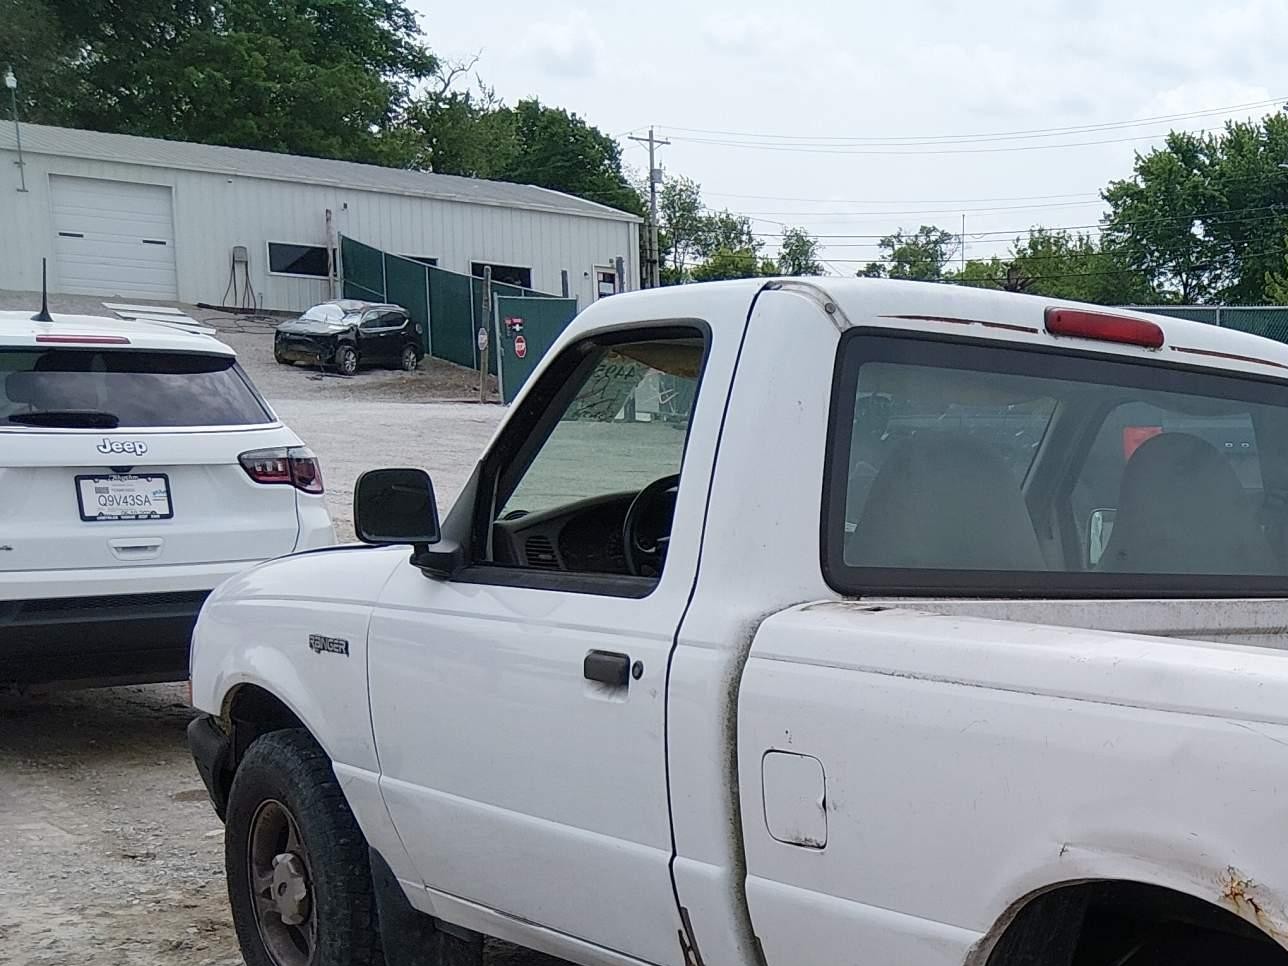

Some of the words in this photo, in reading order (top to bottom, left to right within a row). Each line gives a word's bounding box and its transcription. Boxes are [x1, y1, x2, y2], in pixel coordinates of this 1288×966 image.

[97, 438, 147, 456] Jeep
[98, 495, 152, 506] Q9V43SA
[309, 634, 349, 657] RANGER
